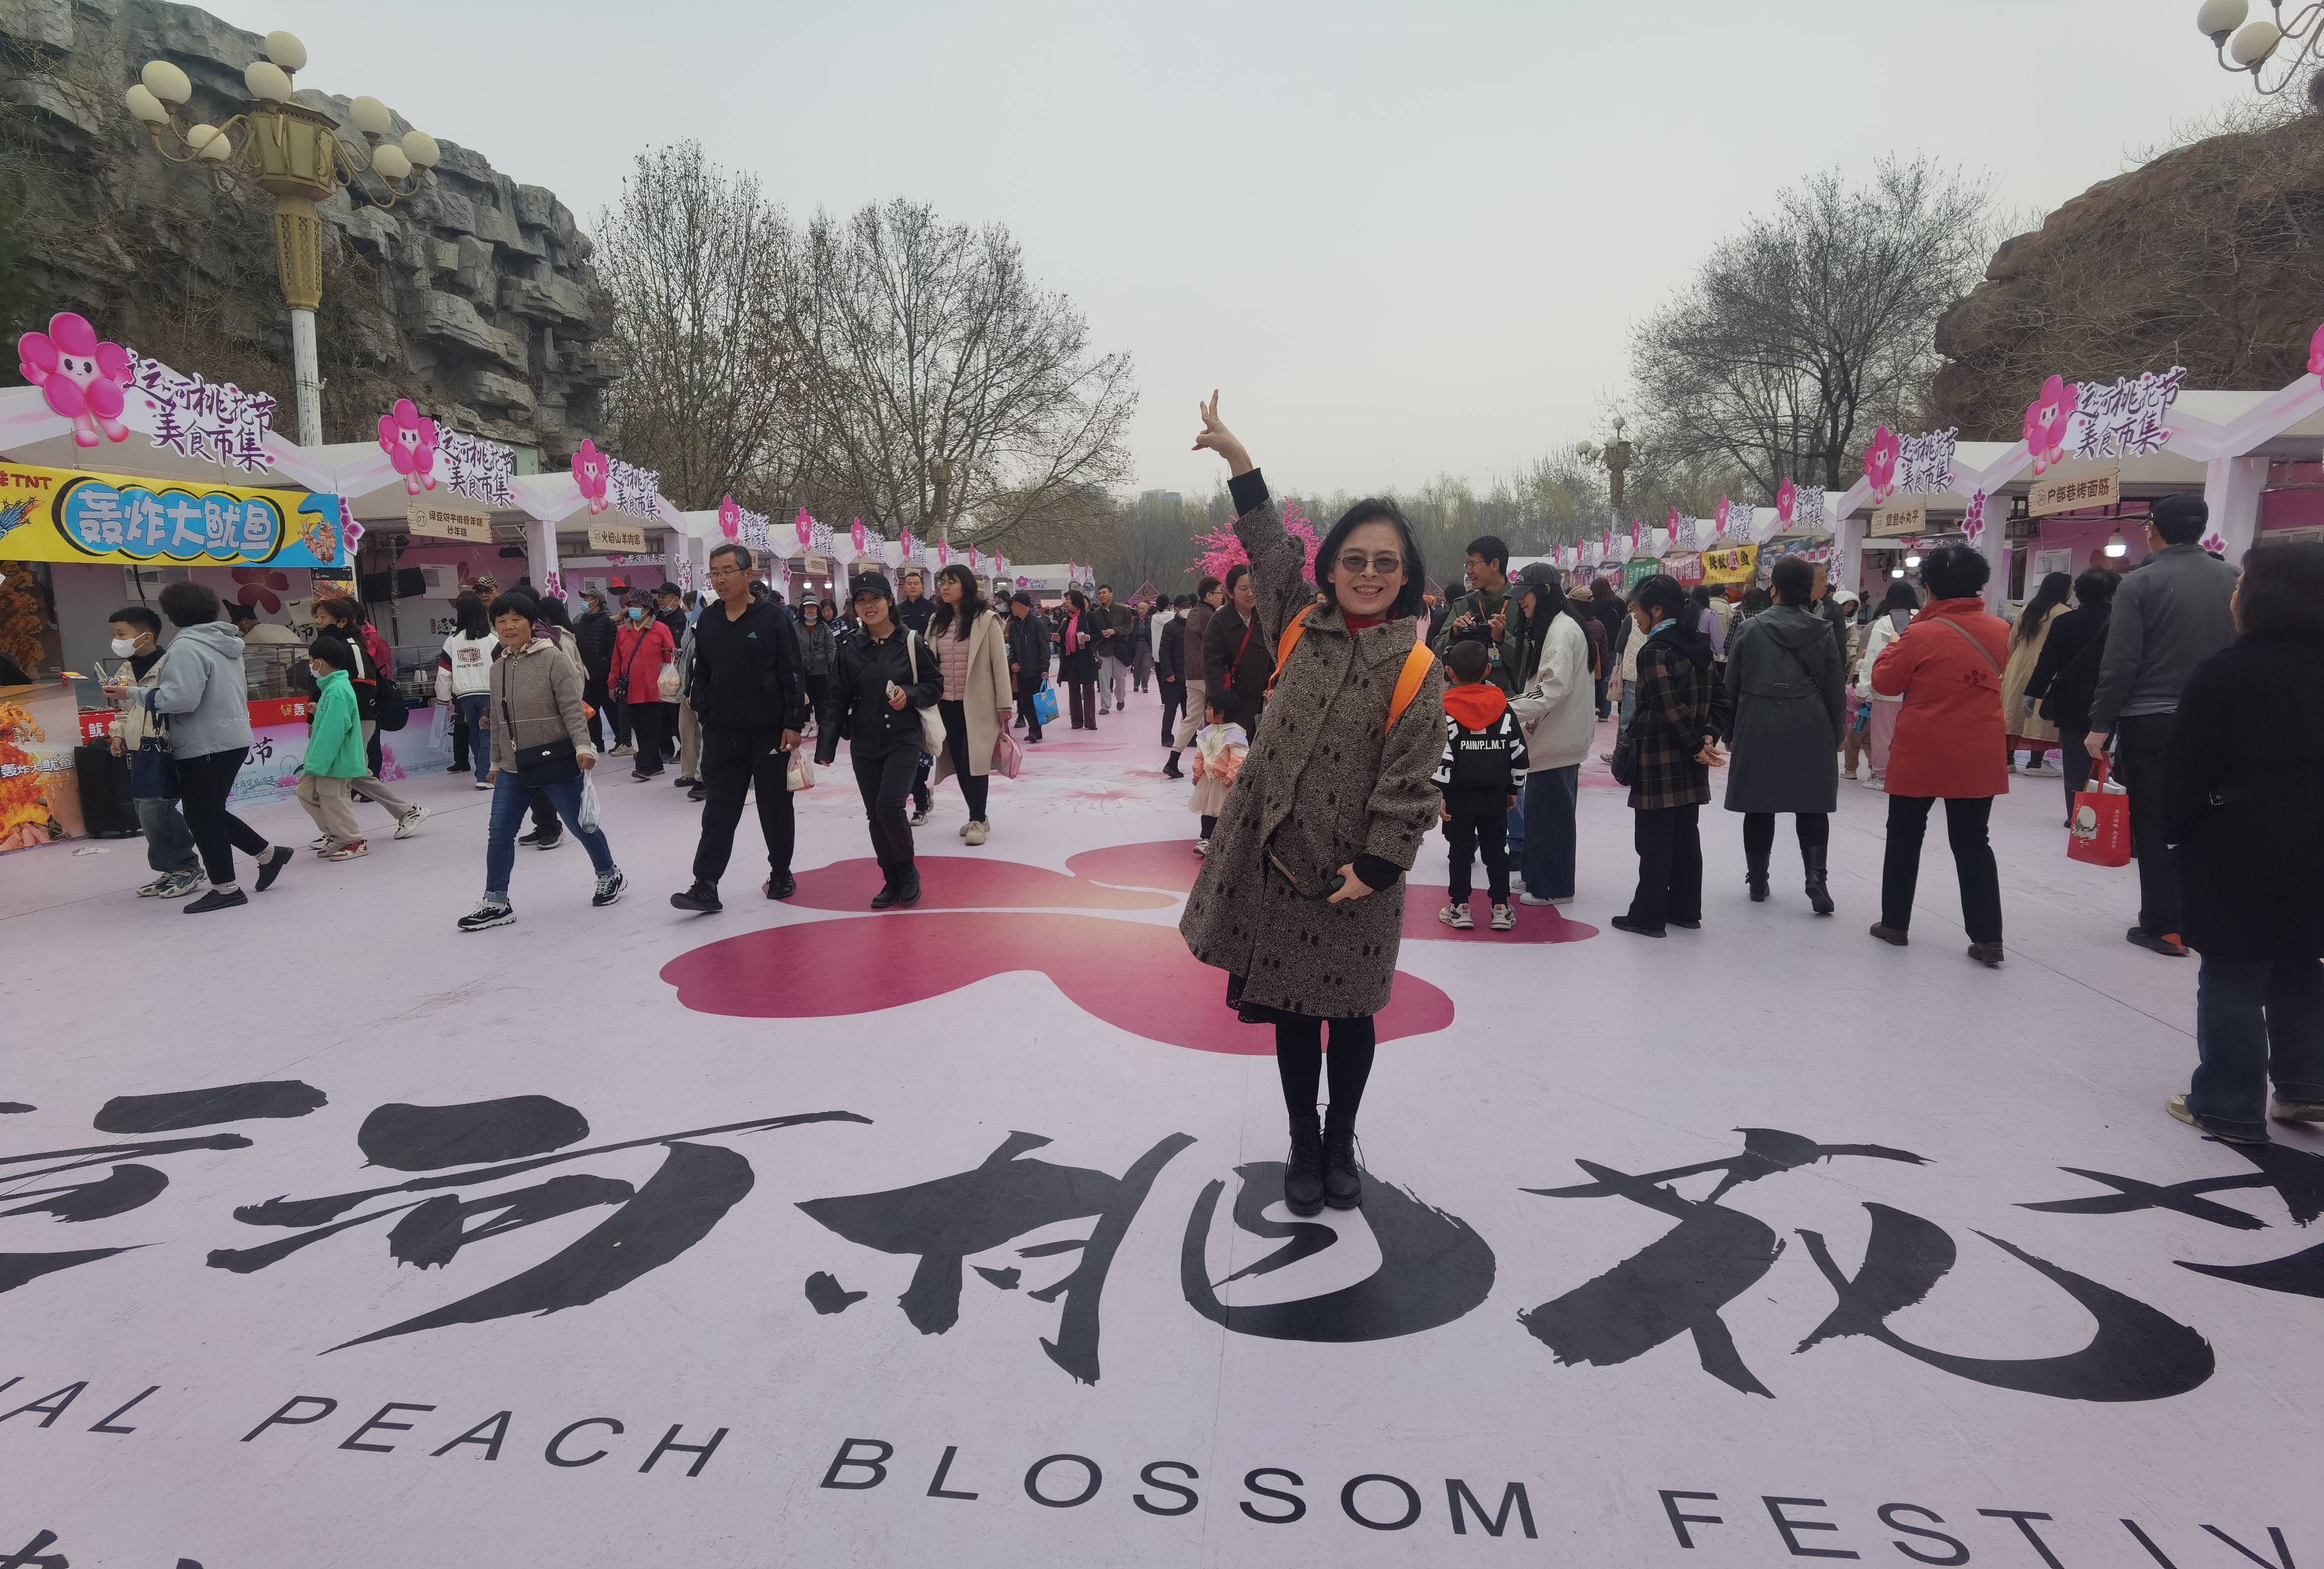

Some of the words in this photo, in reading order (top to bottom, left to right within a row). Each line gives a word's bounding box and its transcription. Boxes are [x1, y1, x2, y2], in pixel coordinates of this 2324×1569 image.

[123, 350, 276, 444] 运河桃花节
[2069, 369, 2186, 426] 运河桃花节
[152, 404, 268, 474] 美食市集
[433, 424, 514, 485] 运河桃花节
[1896, 428, 1957, 471] 运河桃花节
[2075, 410, 2161, 458] 美食市集
[449, 460, 511, 507] 美食市集
[606, 456, 660, 502] 运河桃花节
[1902, 458, 1948, 492] 美食市集
[2047, 478, 2110, 505] 户部巷烤面筋
[77, 488, 271, 550] 轰炸大鱿鱼
[616, 485, 659, 521] 美食市集
[1886, 510, 1919, 526] 章鱼小丸子
[447, 525, 468, 536] 炒年糕
[602, 530, 640, 545] 火焰山羊肉串
[1, 755, 73, 778] 轰炸大鱿鱼
[0, 1377, 162, 1434] AL
[241, 1395, 730, 1477] PEACH
[820, 1438, 1539, 1539] BLOSSOM
